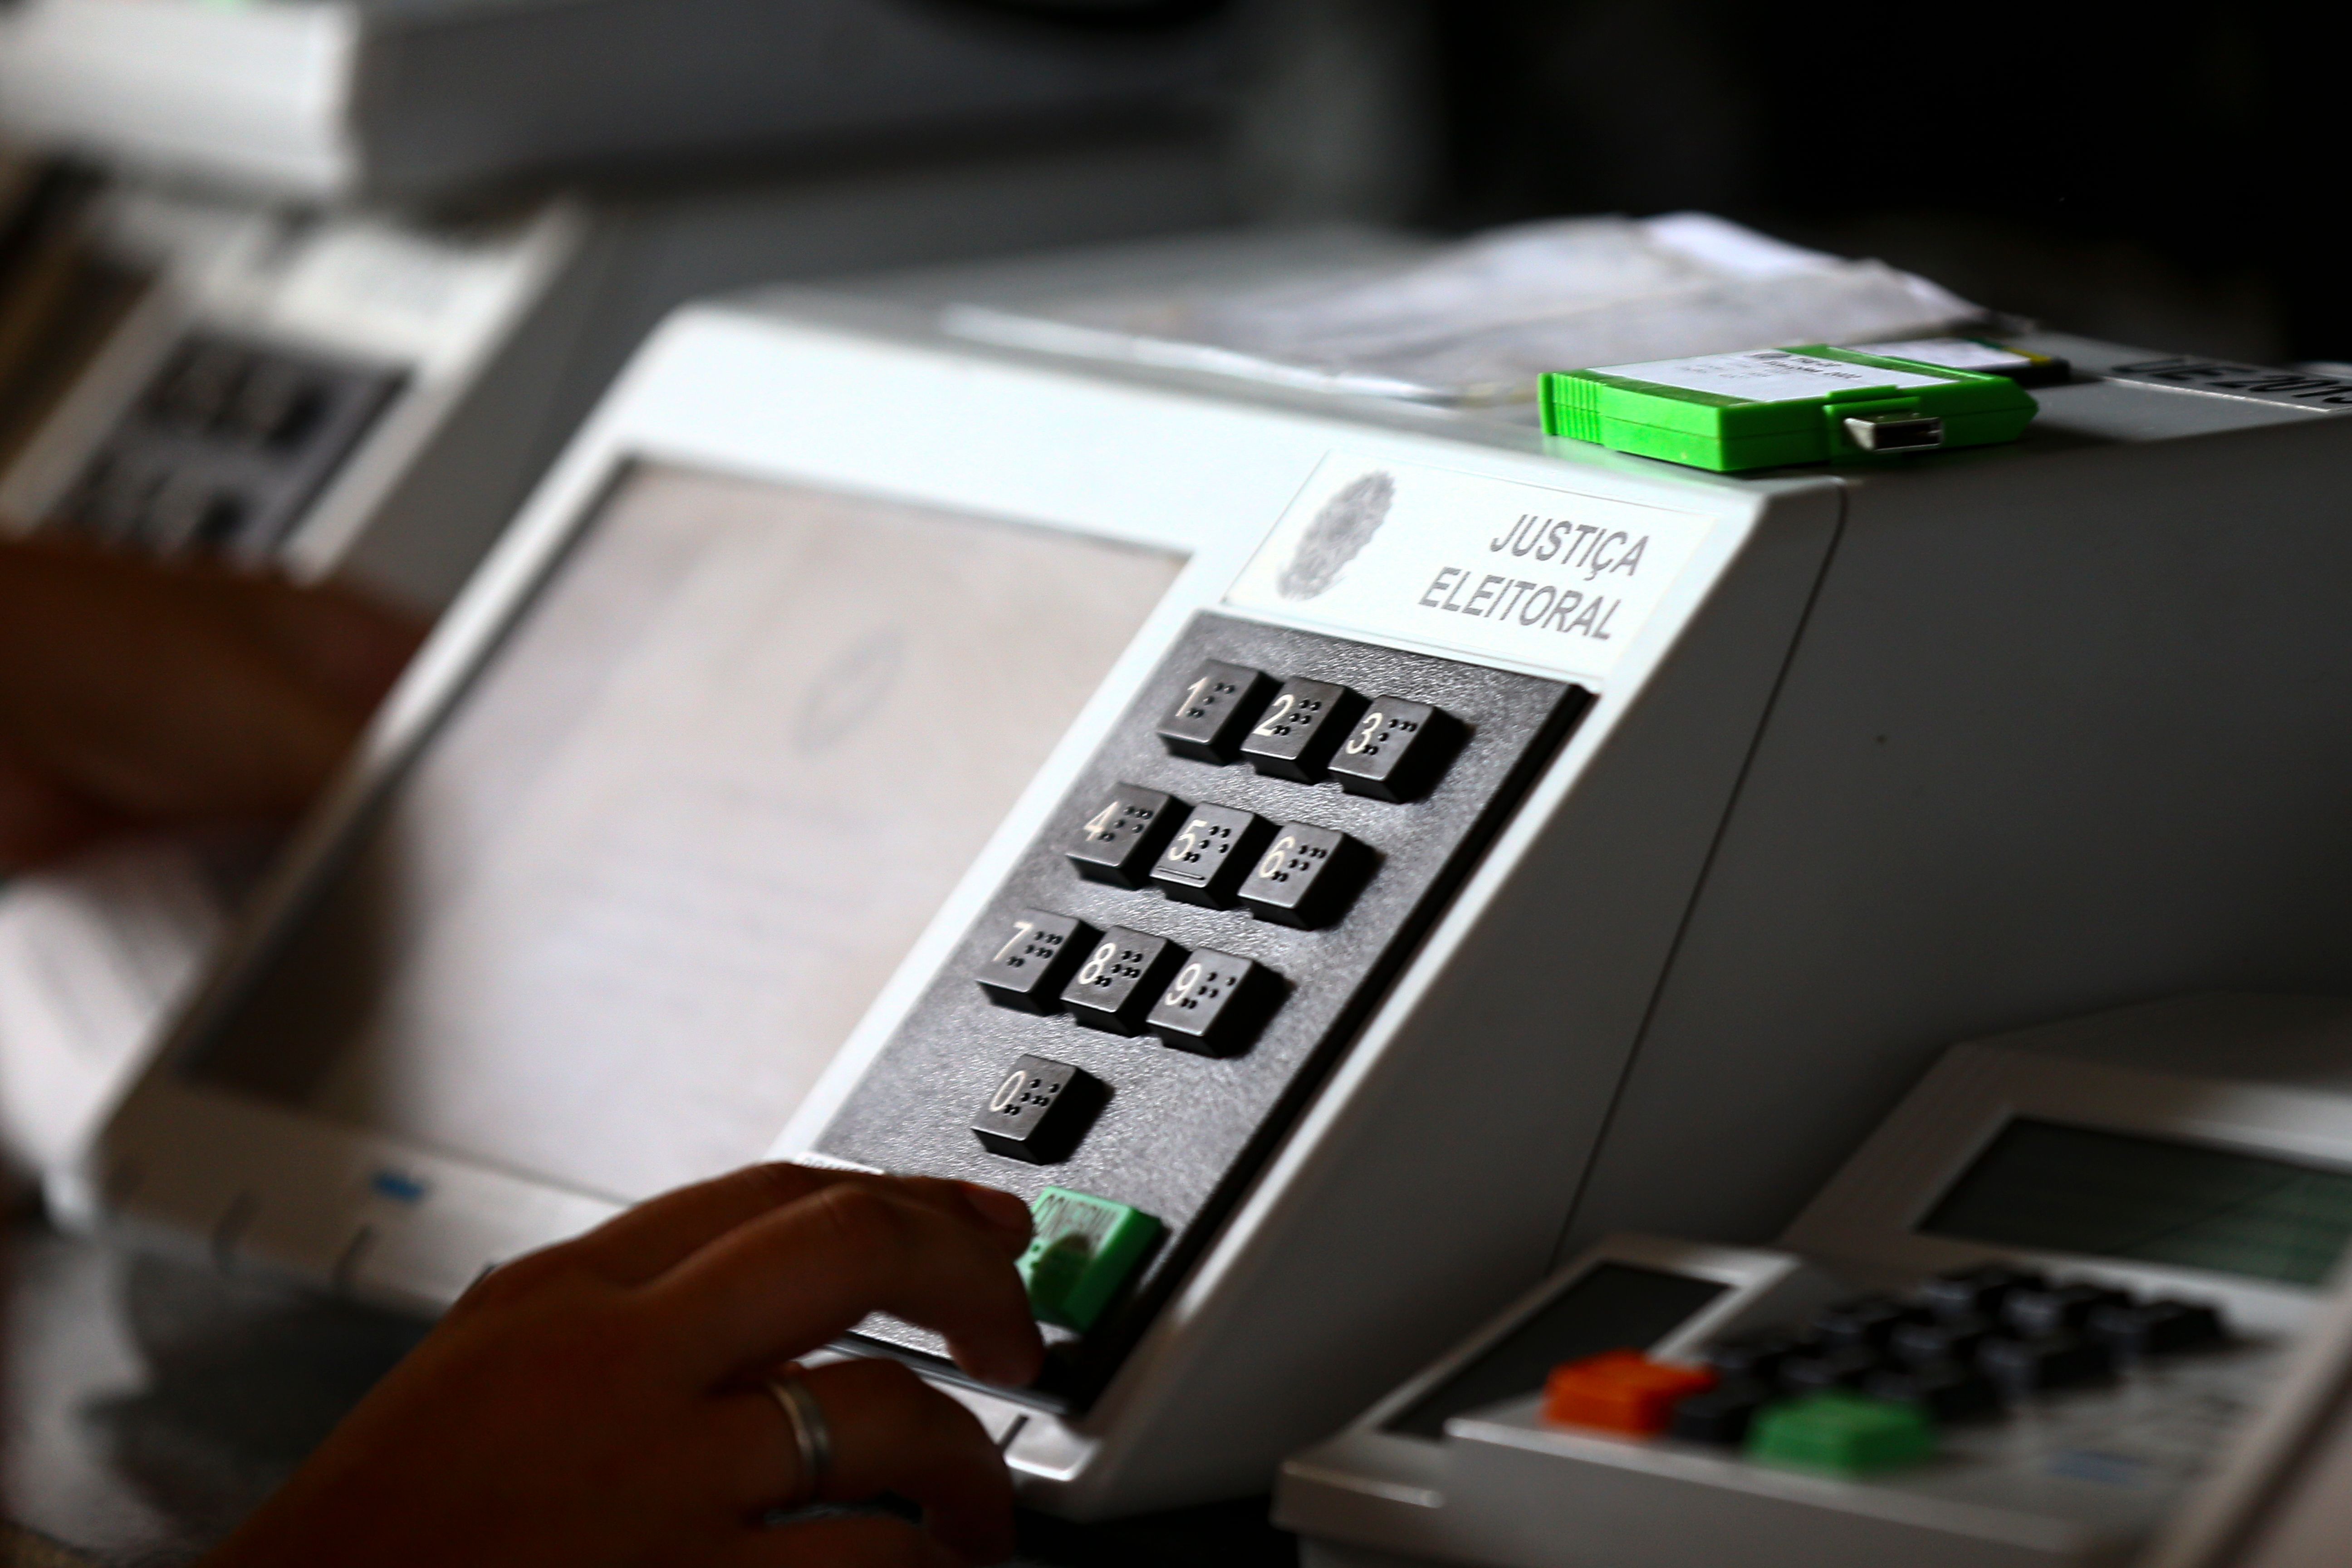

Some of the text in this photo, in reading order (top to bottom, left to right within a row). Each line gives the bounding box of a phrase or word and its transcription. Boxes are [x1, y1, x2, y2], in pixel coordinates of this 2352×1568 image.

[1490, 514, 1650, 582] JUSTIÇA
[1417, 567, 1623, 641] ELEITORAL
[1174, 676, 1383, 755] 1 2 3
[1085, 800, 1295, 877] 4 5 6
[993, 921, 1201, 1005] 7 8 9
[989, 1070, 1026, 1113] 0
